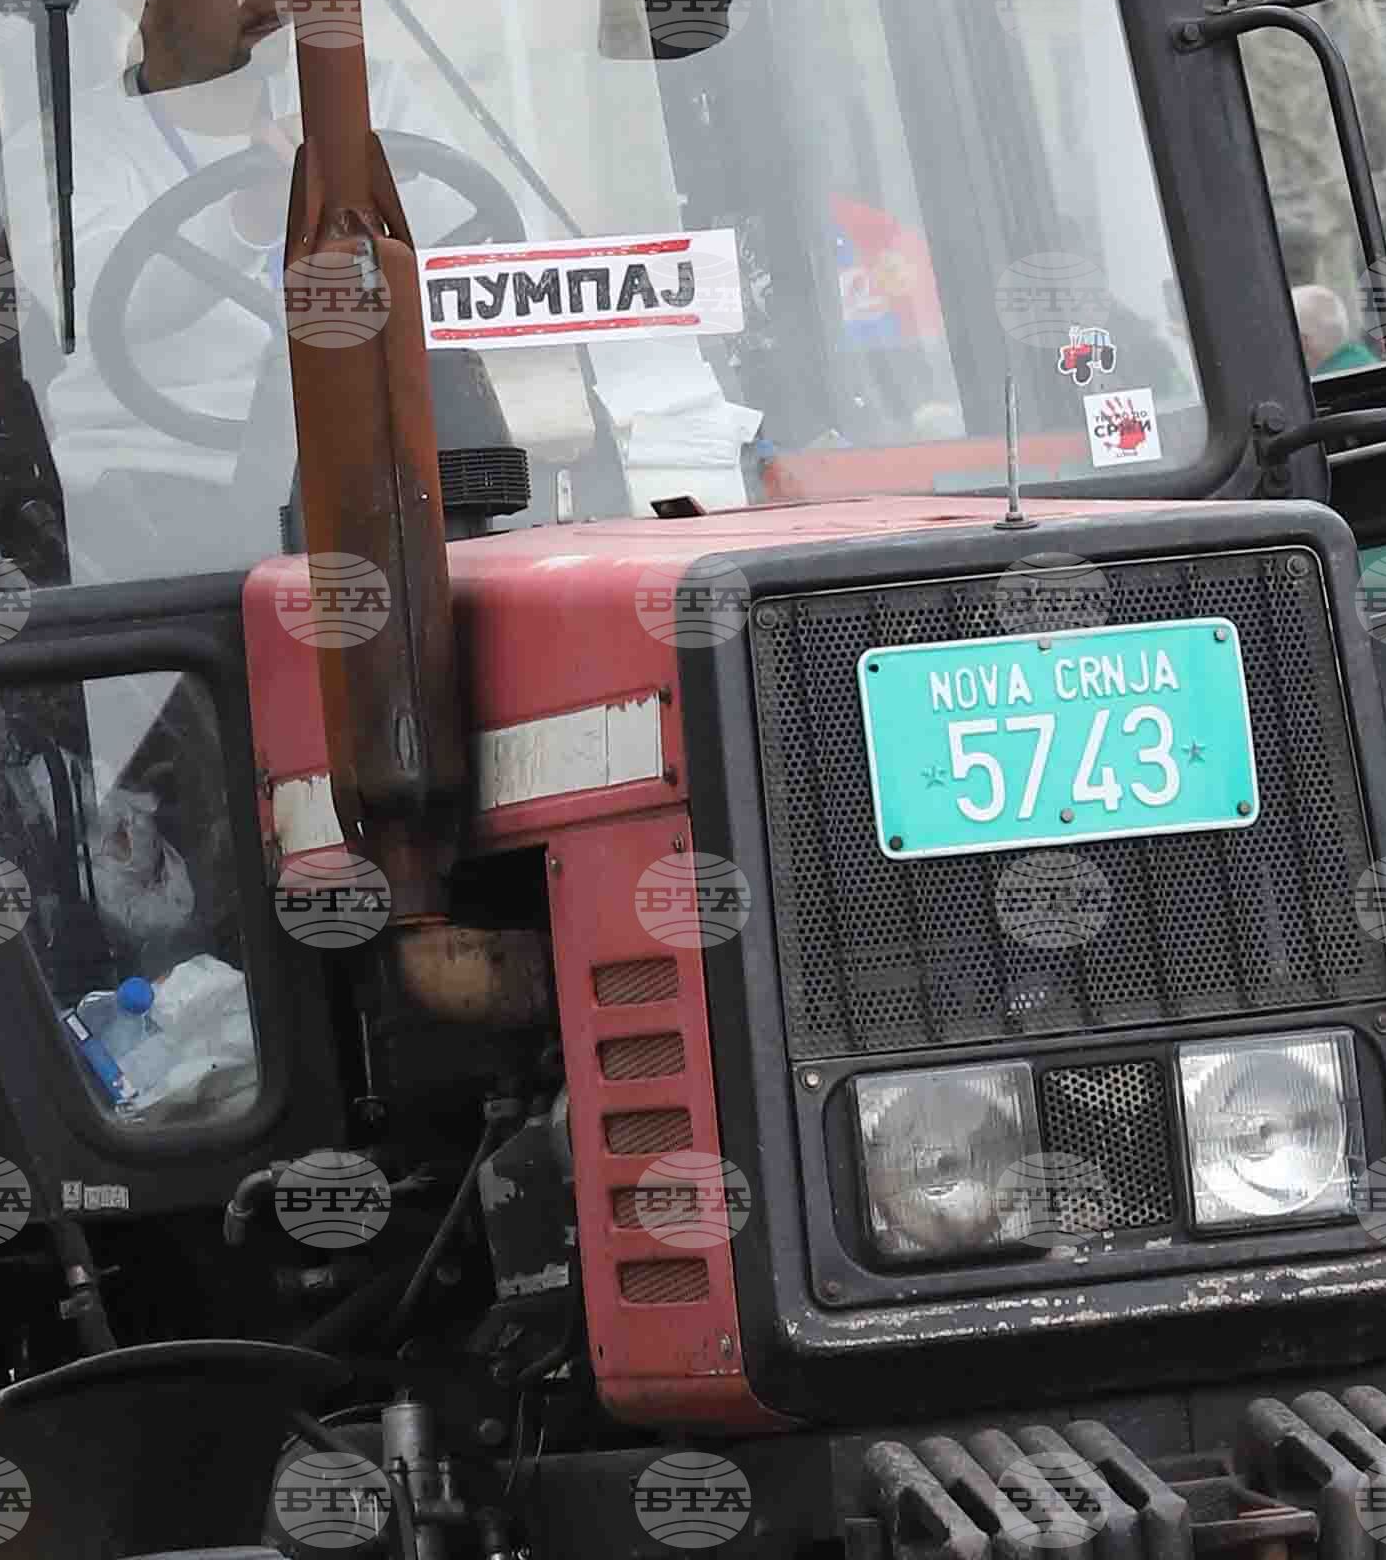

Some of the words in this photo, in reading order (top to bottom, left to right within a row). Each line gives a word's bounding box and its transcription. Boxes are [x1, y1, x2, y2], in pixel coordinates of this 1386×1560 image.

[426, 261, 696, 323] ПУМПАЈ
[928, 662, 1034, 713] NOVA
[1053, 649, 1181, 702] CRNJA
[947, 703, 1182, 823] 5743
